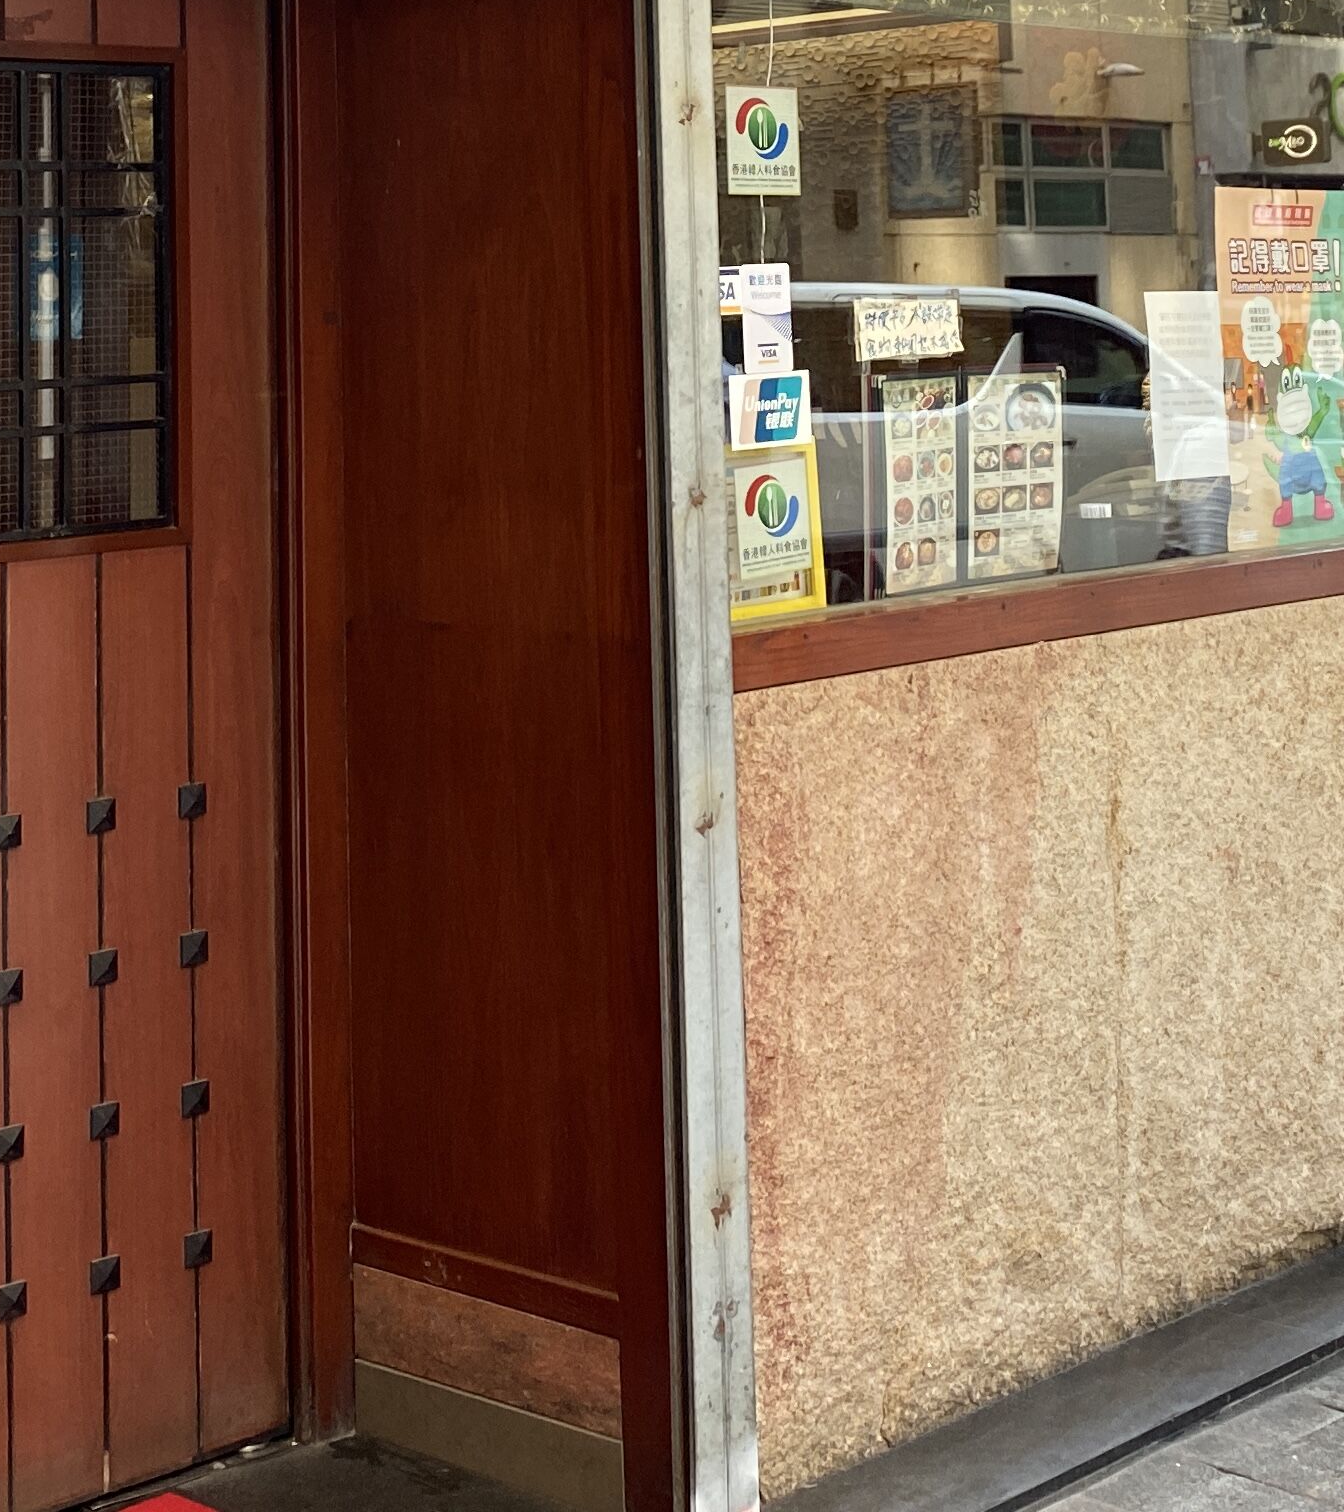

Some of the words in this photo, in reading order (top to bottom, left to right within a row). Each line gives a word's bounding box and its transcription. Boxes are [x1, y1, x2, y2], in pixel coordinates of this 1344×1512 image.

[1231, 278, 1274, 294] Remember
[1275, 279, 1284, 293] to
[1284, 281, 1304, 293] wear
[1311, 280, 1333, 293] mask
[760, 348, 778, 359] VISA
[744, 391, 800, 414] UnionPay
